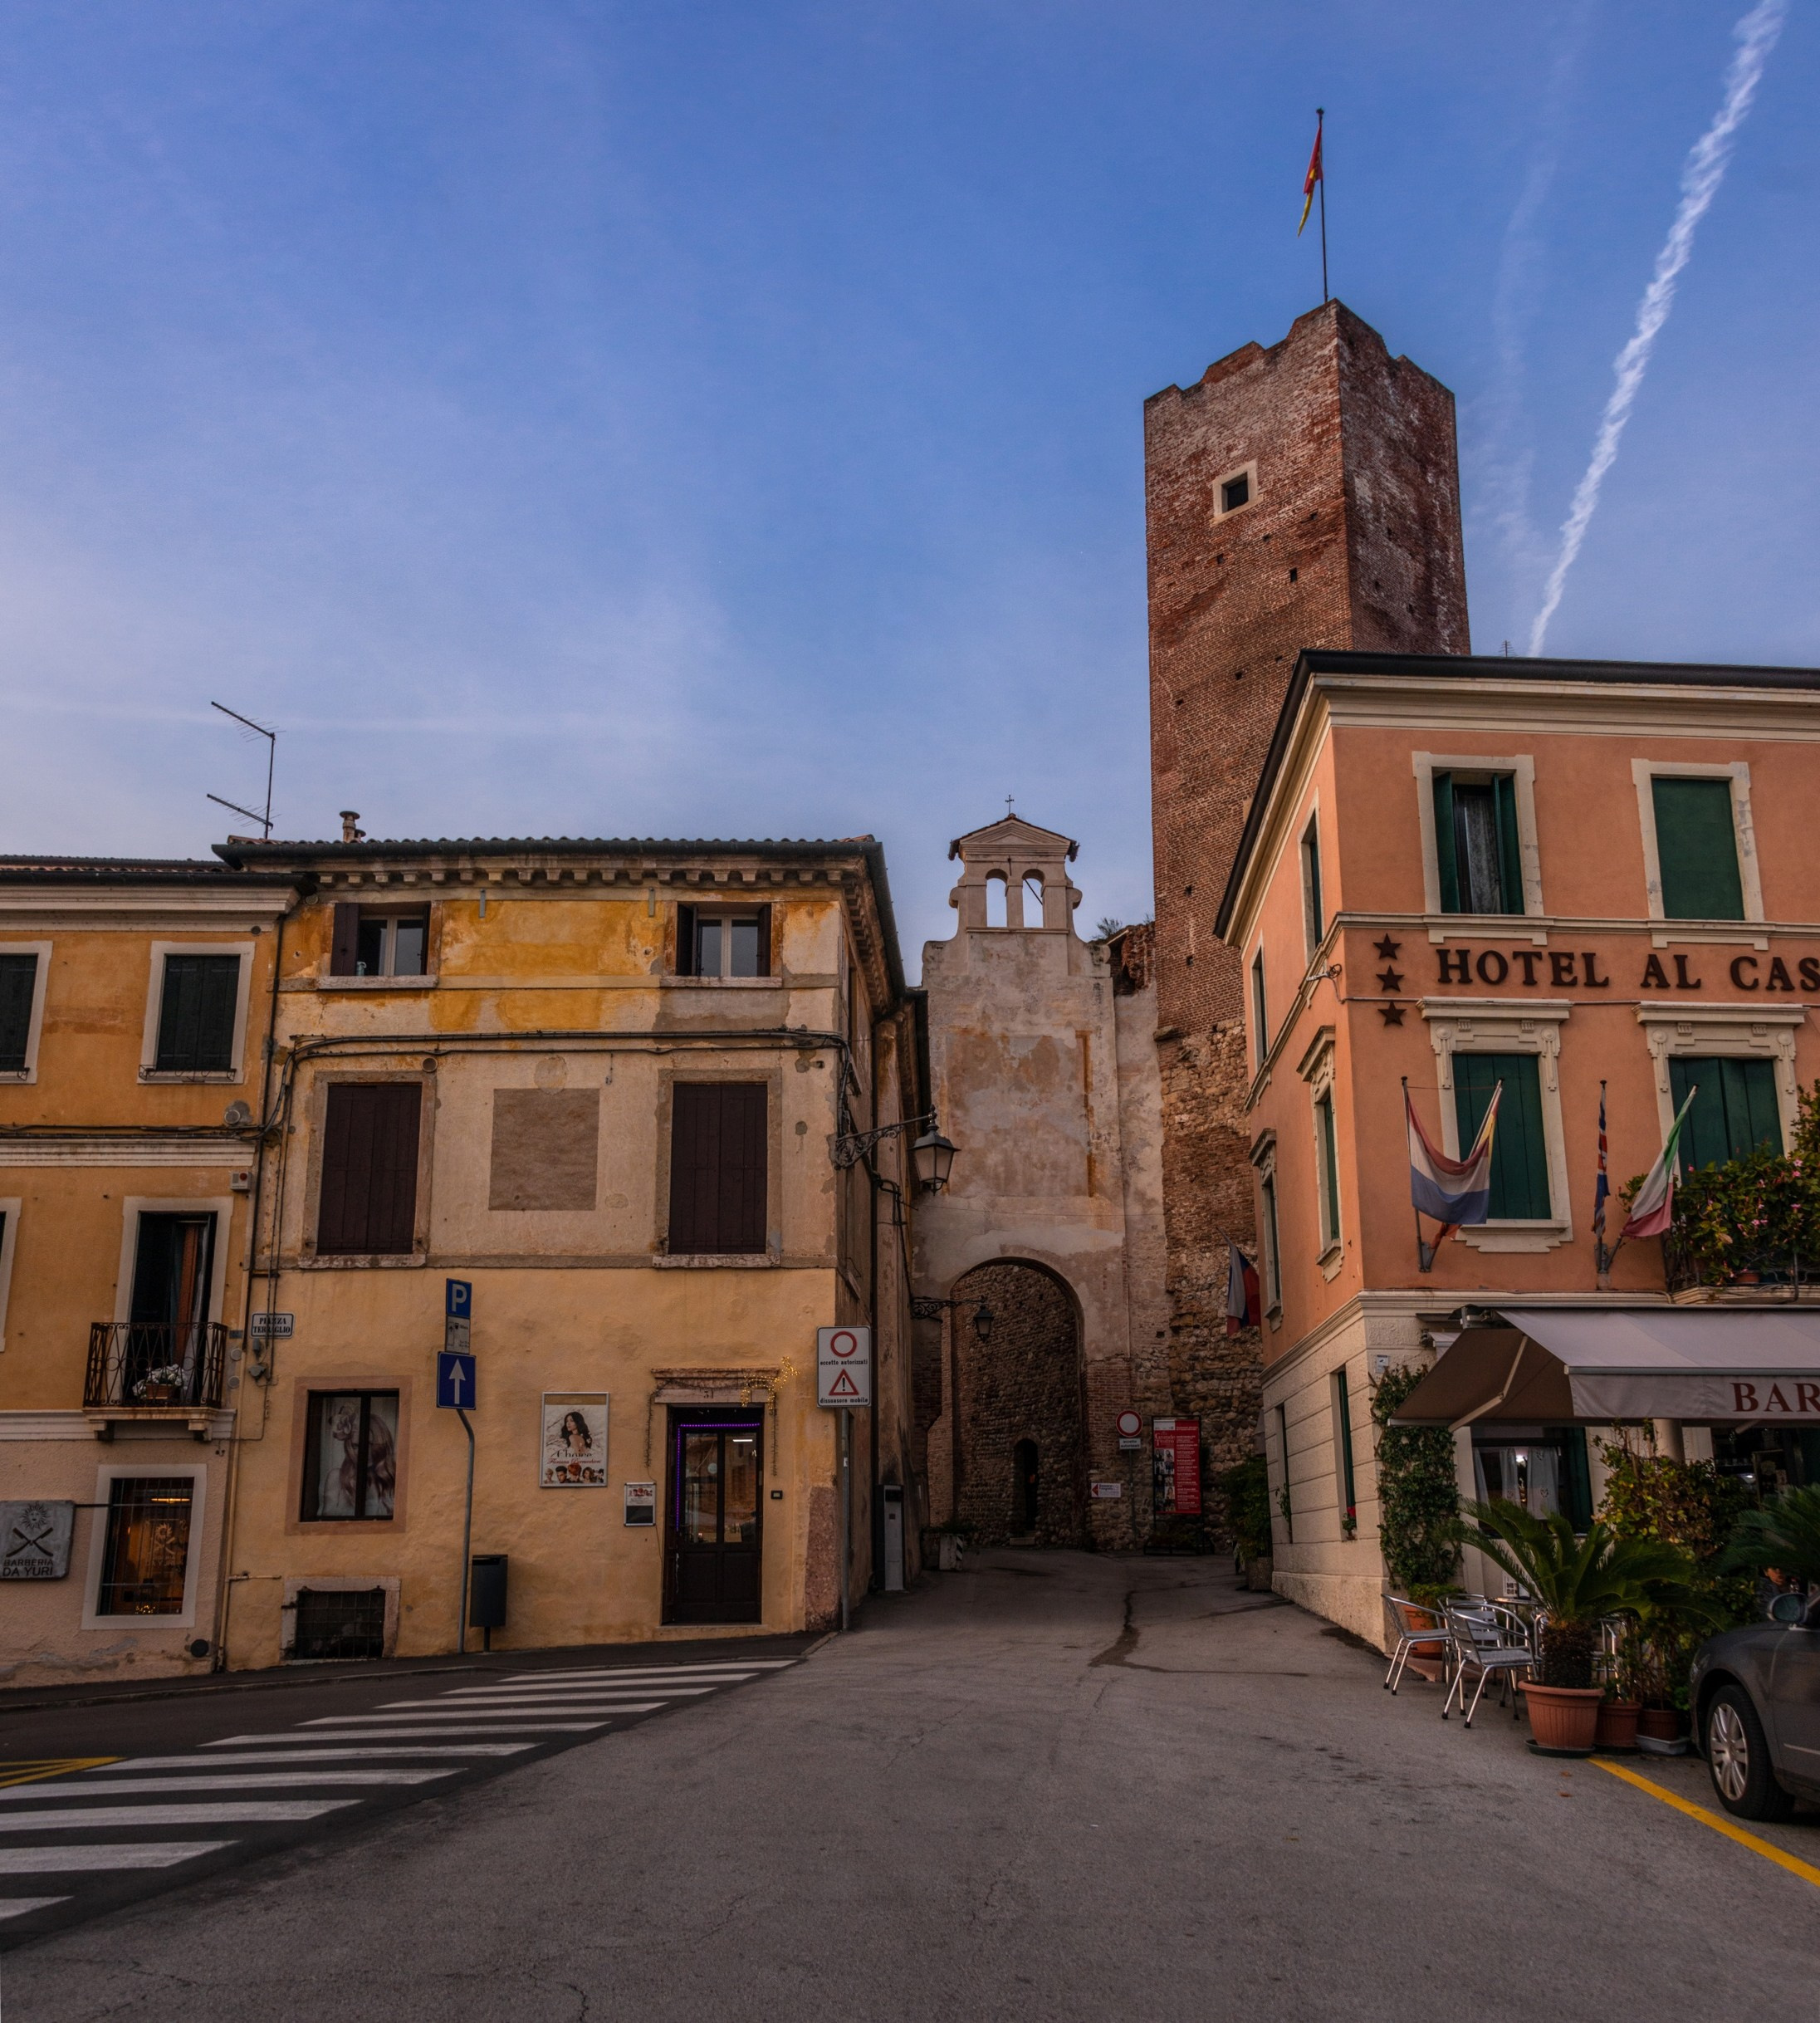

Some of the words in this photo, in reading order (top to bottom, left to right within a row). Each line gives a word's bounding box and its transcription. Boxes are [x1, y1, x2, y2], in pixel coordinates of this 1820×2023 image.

[1436, 949, 1609, 987] HOTEL
[1641, 954, 1701, 988] AL
[1730, 957, 1820, 992] CAS
[452, 1284, 467, 1312] P
[253, 1325, 291, 1334] TERRGLIO
[1729, 1383, 1820, 1413] BAR
[2, 1566, 20, 1576] DA
[25, 1566, 53, 1576] YURI
[3, 1559, 54, 1567] BARBERIA
